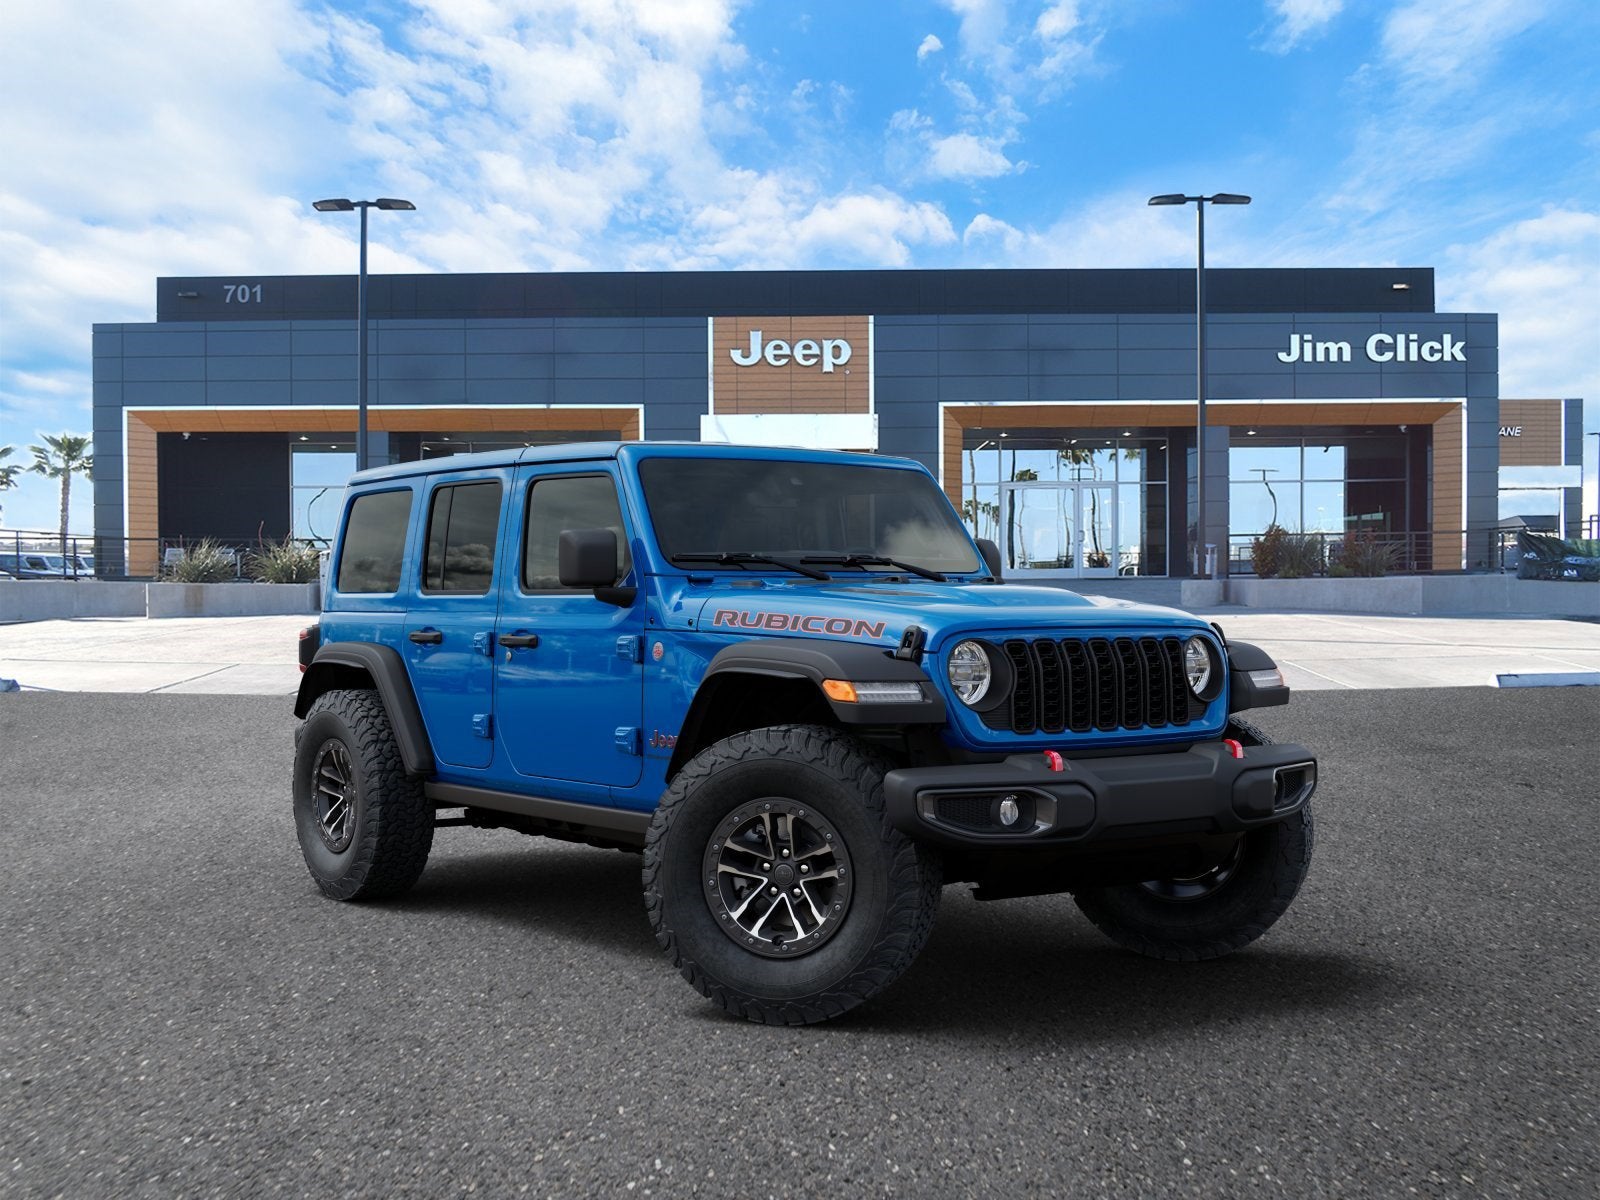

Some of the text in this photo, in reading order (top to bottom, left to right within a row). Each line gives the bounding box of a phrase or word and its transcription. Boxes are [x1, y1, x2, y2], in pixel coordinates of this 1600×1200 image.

[223, 284, 262, 304] 701
[729, 330, 852, 374] Jeep
[1277, 333, 1467, 363] Jim Click
[713, 608, 887, 639] RUBICON
